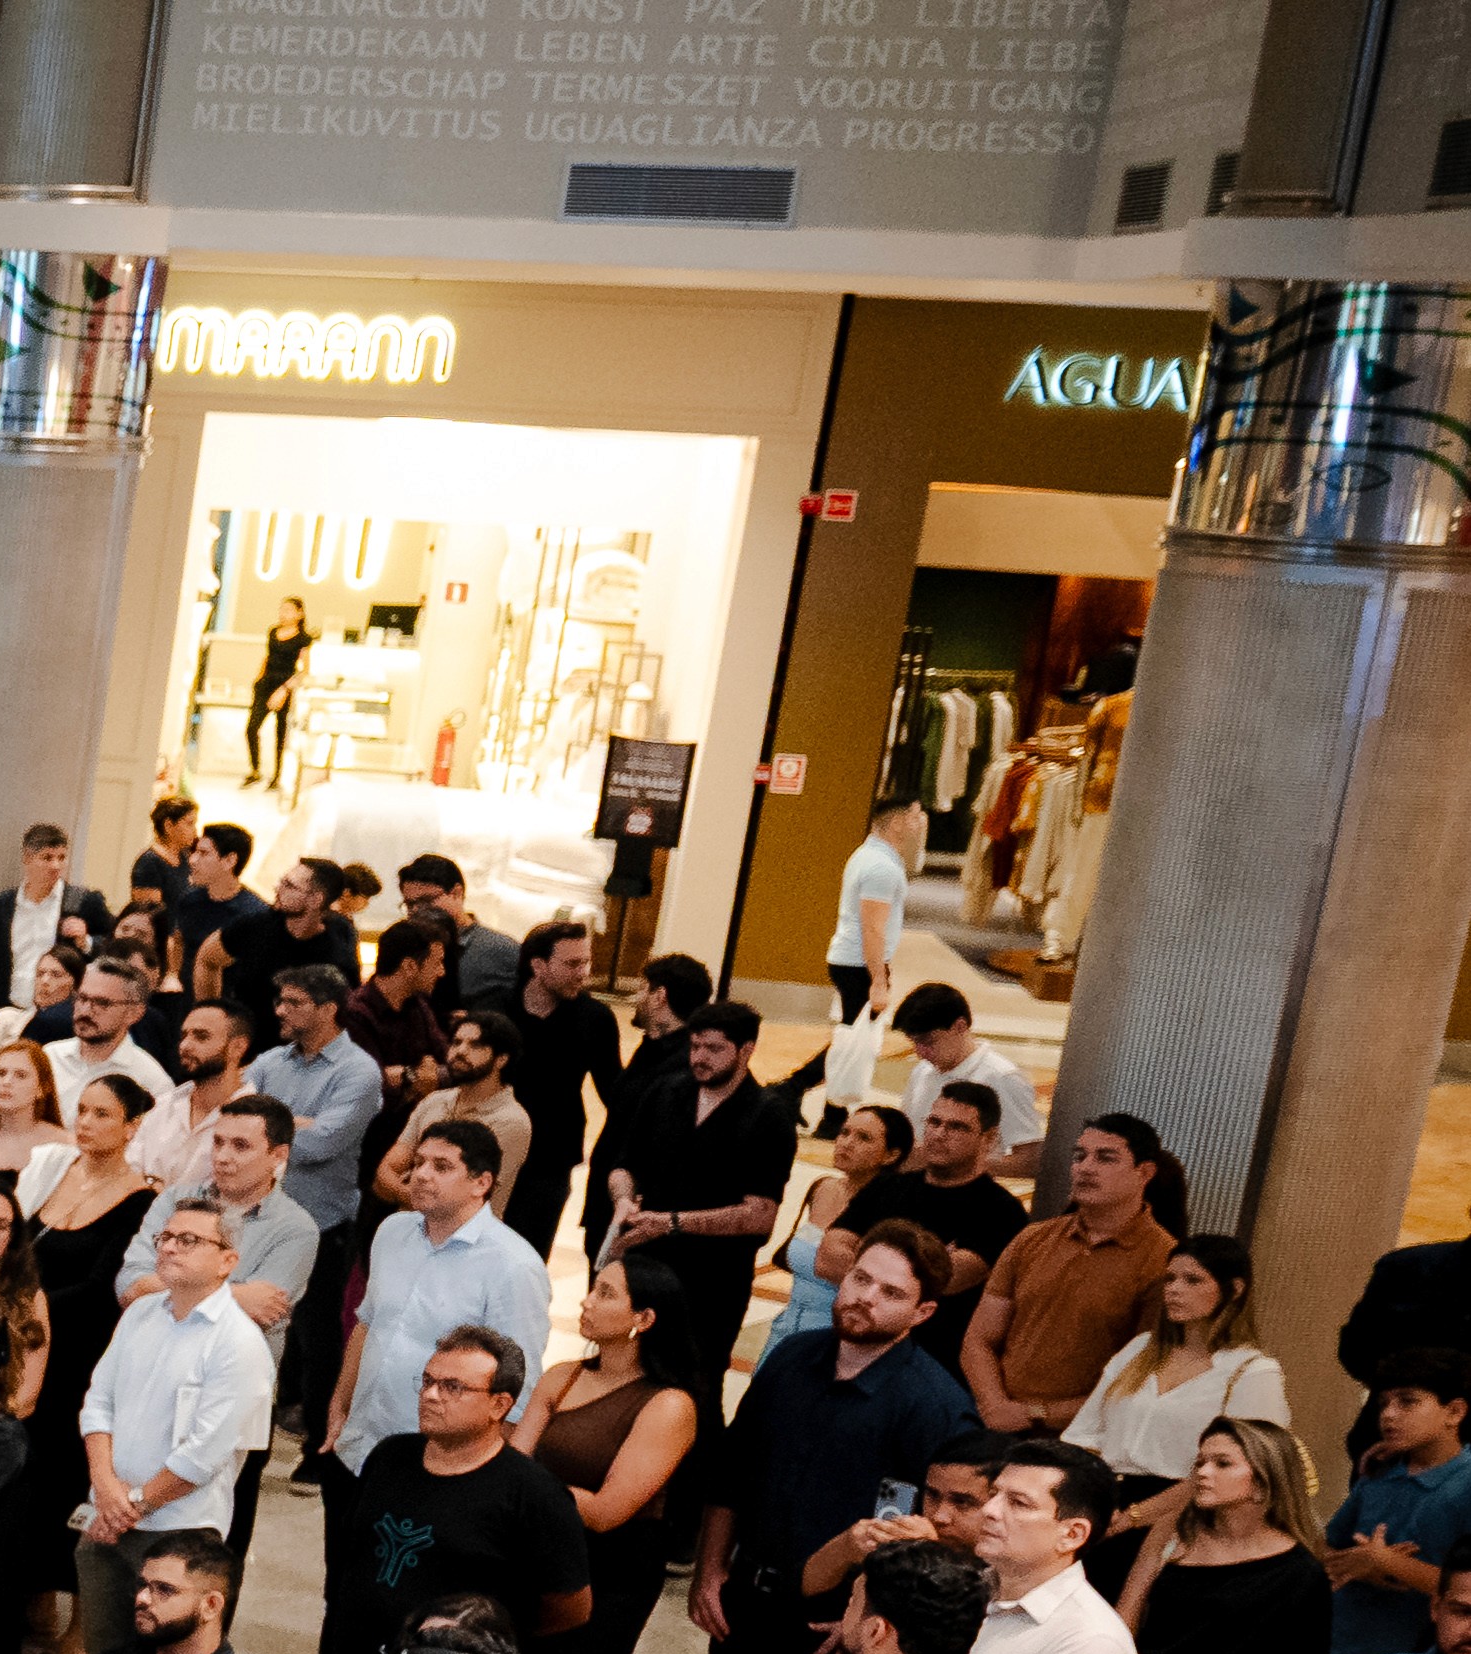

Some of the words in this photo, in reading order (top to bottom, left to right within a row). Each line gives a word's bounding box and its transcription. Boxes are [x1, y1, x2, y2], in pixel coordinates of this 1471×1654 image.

[686, 0, 767, 24] PAZ
[799, 0, 877, 27] TRO
[201, 24, 489, 60] KEMERDEKAAN
[513, 31, 648, 63] LEBEN
[668, 33, 780, 67] ARTE
[807, 36, 946, 69] CINTA
[966, 39, 1109, 72] LIEBE
[195, 63, 507, 100] BROEDERSCHAP
[794, 77, 1105, 113] VOORUITGANG
[191, 102, 502, 140] MIELIKUVITUS
[524, 112, 823, 149] UGUAGLIANZA
[841, 118, 1096, 154] PROGRESSO
